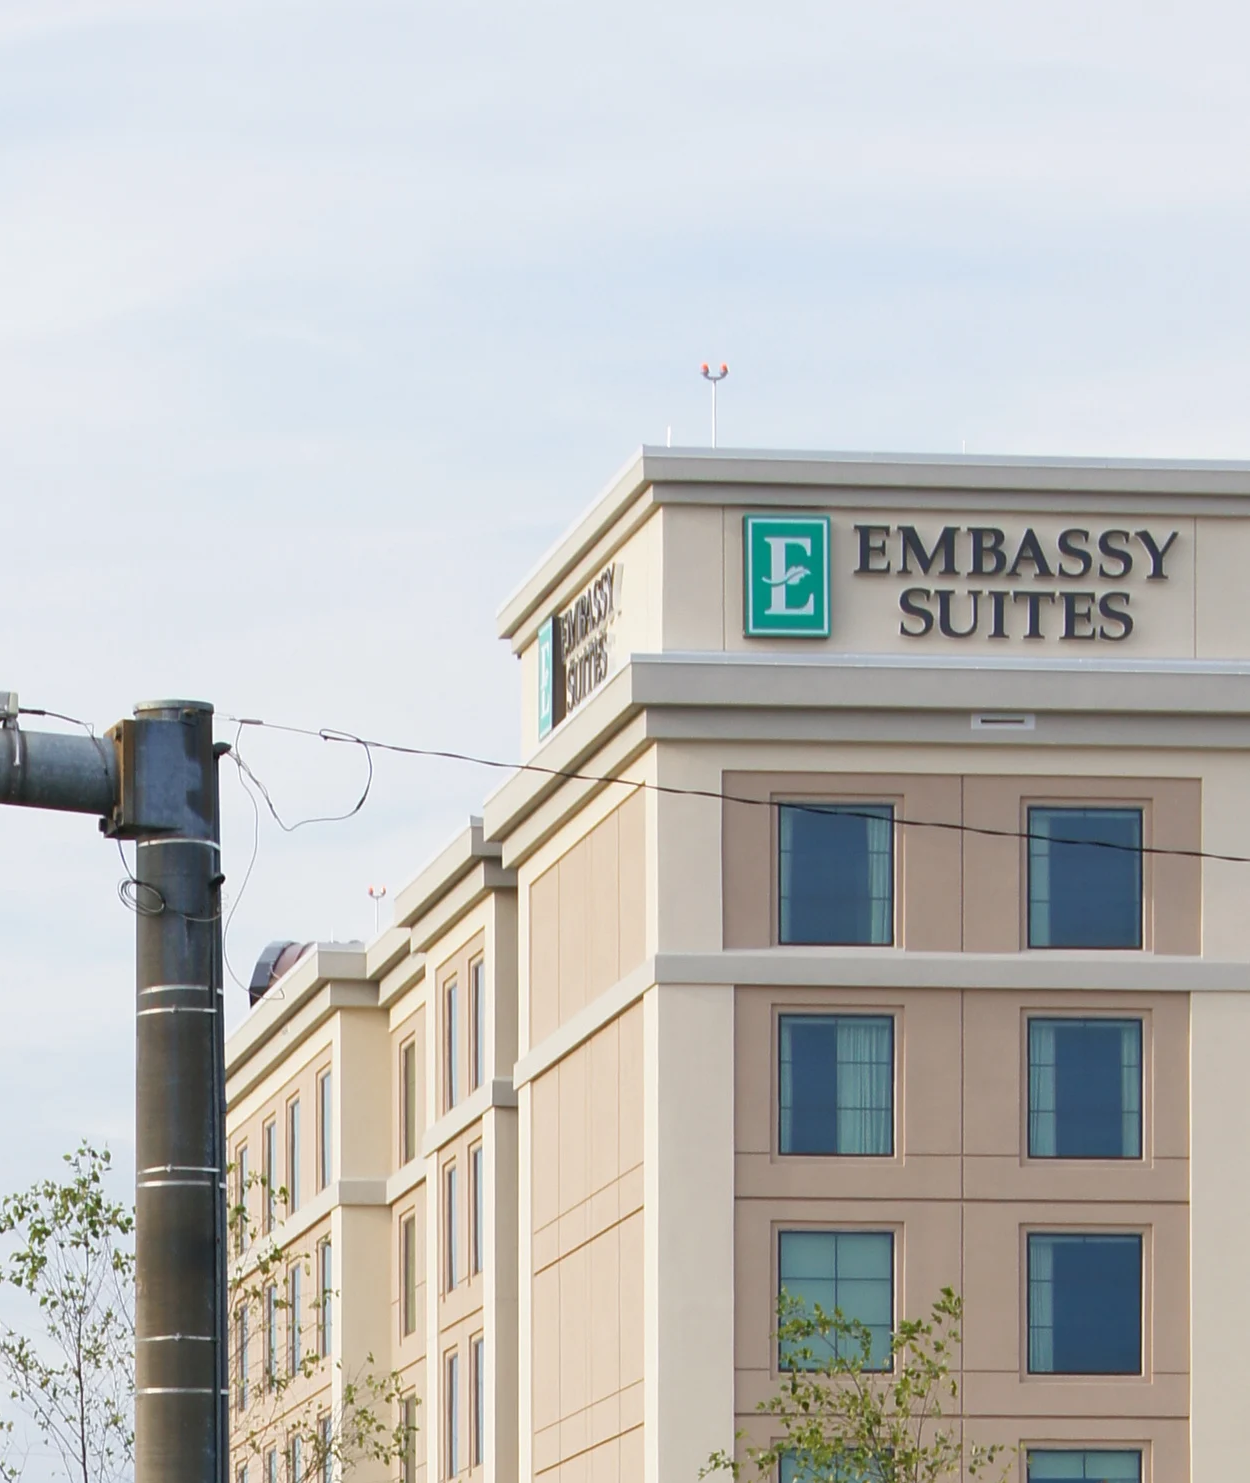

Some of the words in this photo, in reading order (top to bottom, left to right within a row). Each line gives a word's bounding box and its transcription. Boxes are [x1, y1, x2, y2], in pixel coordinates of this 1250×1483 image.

[854, 525, 1179, 580] EMBASSY
[561, 562, 616, 665] EMBASSY
[899, 588, 1134, 642] SUITES
[567, 632, 608, 712] SUITES
